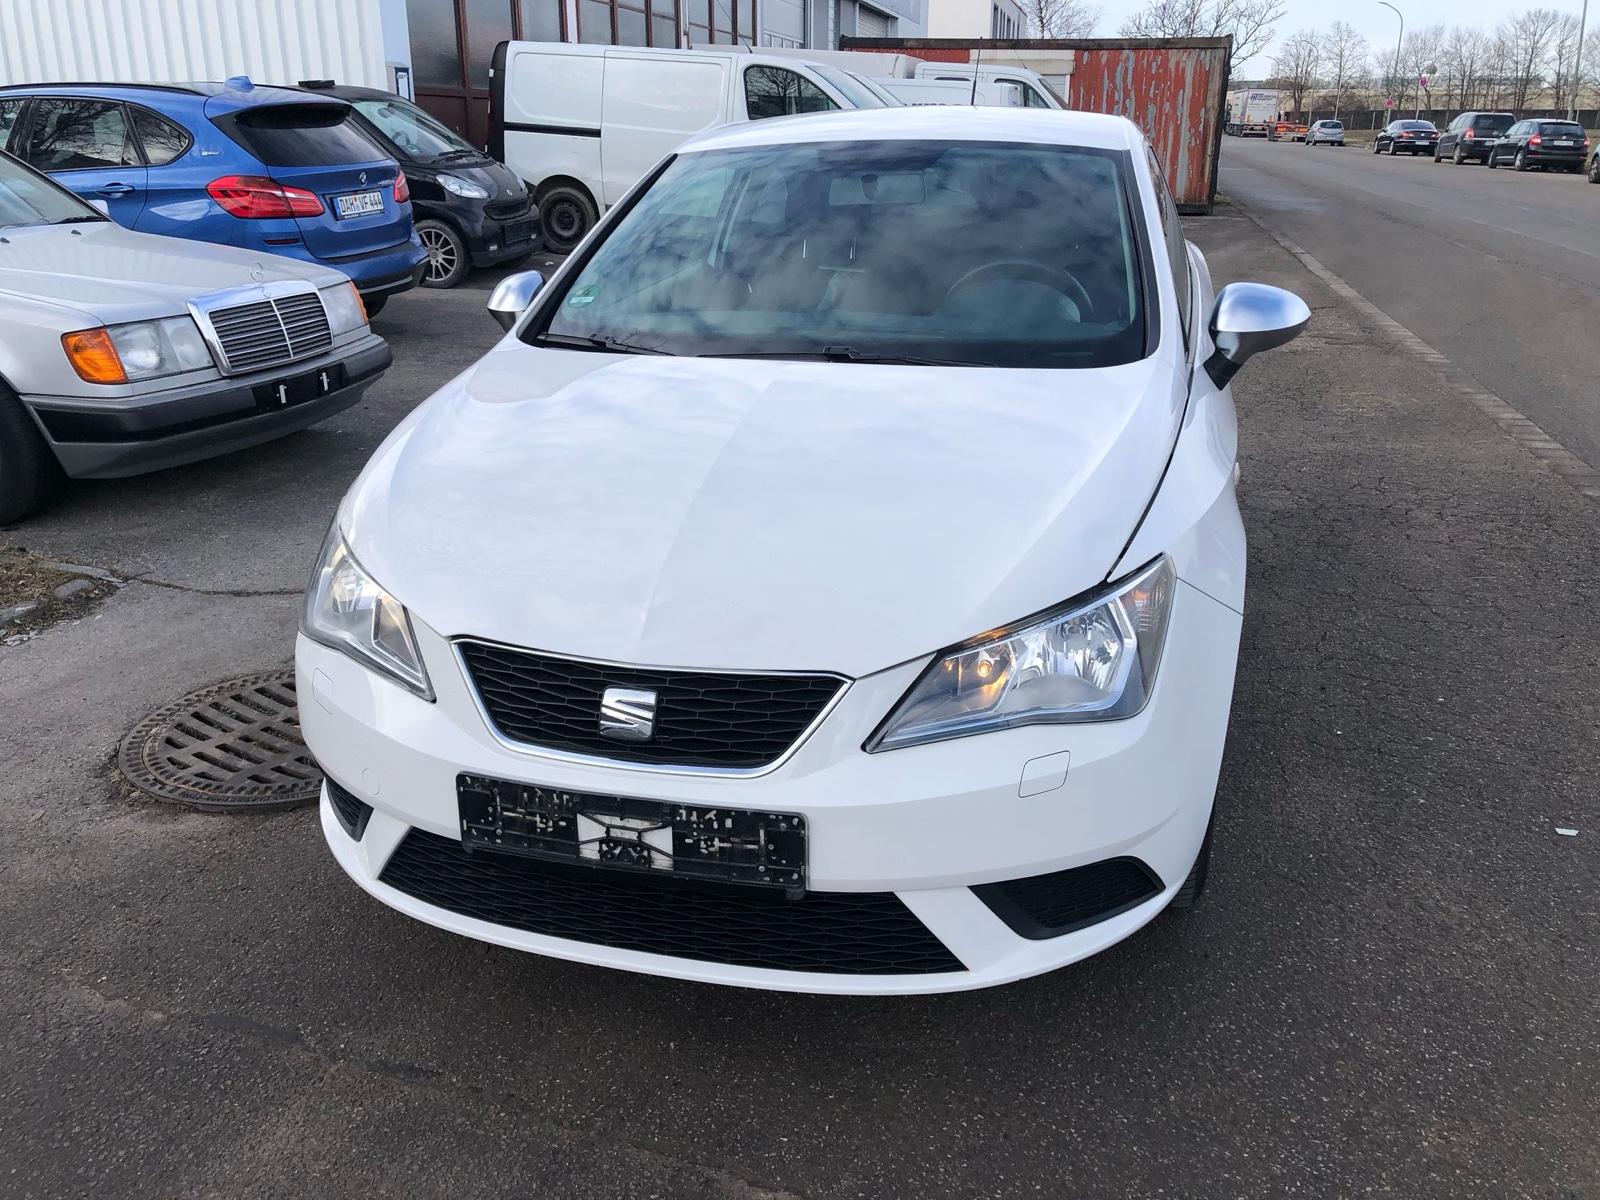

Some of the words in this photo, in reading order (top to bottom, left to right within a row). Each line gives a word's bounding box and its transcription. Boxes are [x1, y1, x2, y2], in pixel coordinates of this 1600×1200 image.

[339, 197, 355, 213] DAH
[358, 195, 368, 210] VF
[369, 193, 382, 208] 444
